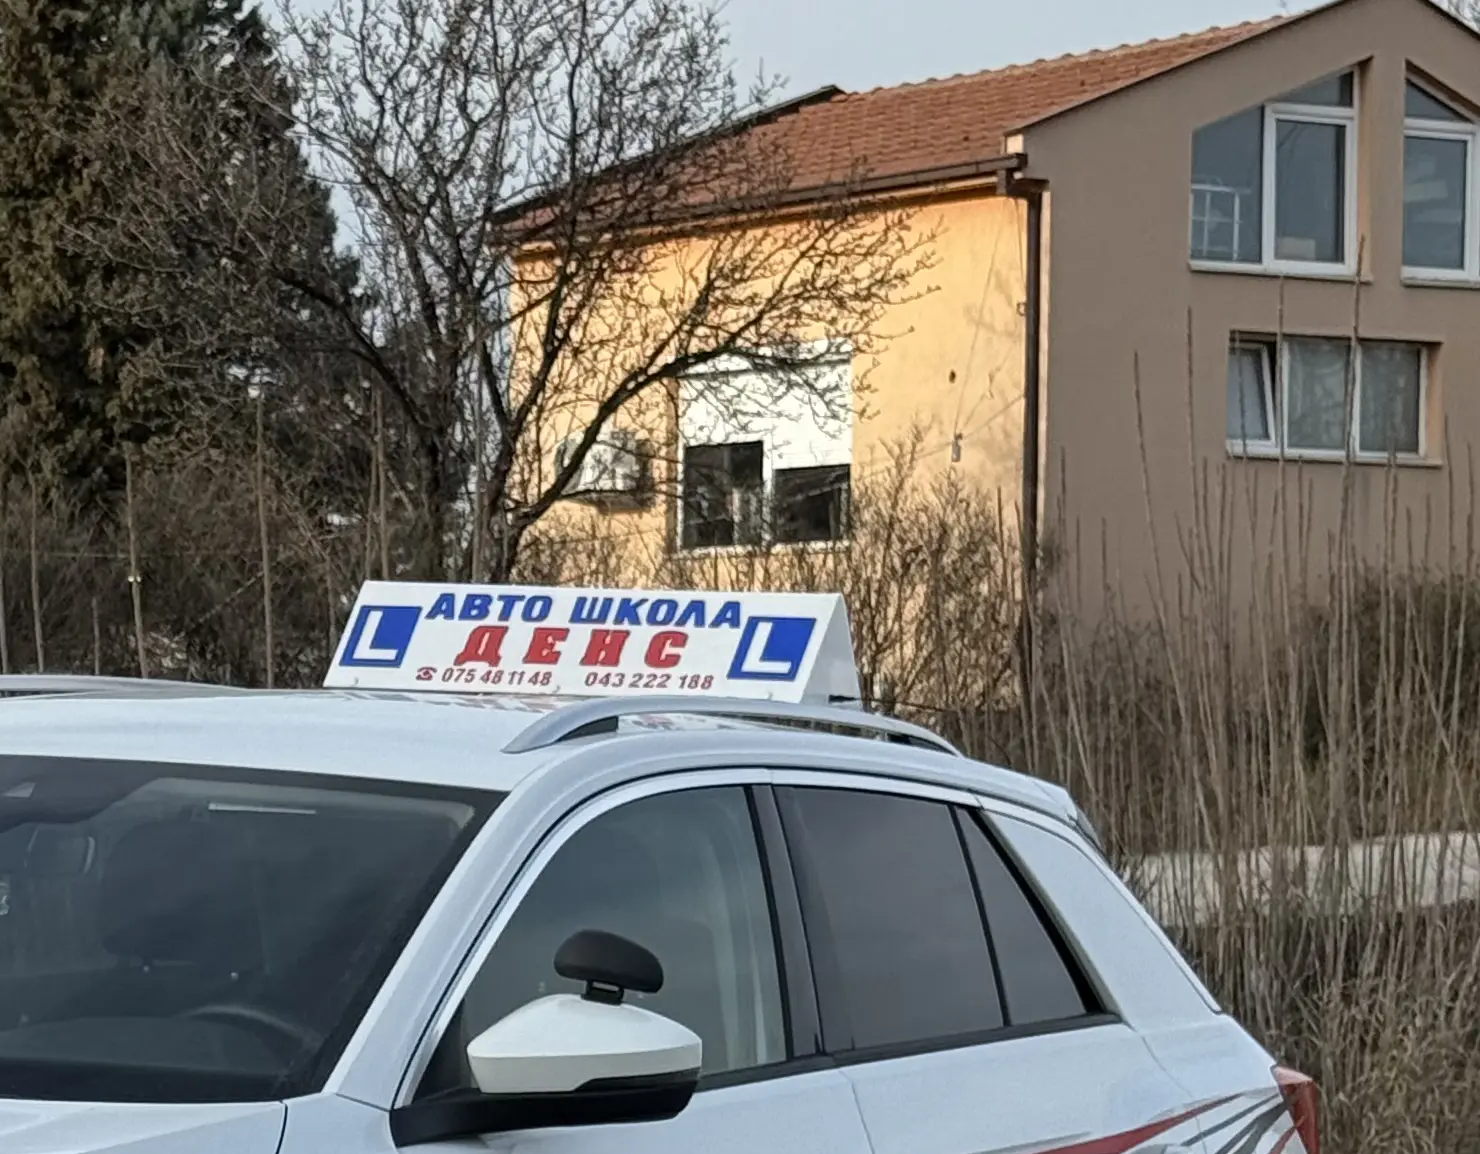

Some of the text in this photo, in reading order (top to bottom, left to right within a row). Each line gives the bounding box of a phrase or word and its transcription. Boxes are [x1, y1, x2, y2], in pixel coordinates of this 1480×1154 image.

[424, 592, 741, 628] АВТО ШКОЛА
[352, 610, 399, 660] L
[453, 625, 689, 669] ДЕНС
[740, 620, 793, 675] L
[441, 667, 477, 684] 075
[584, 671, 715, 690] 043 222 188
